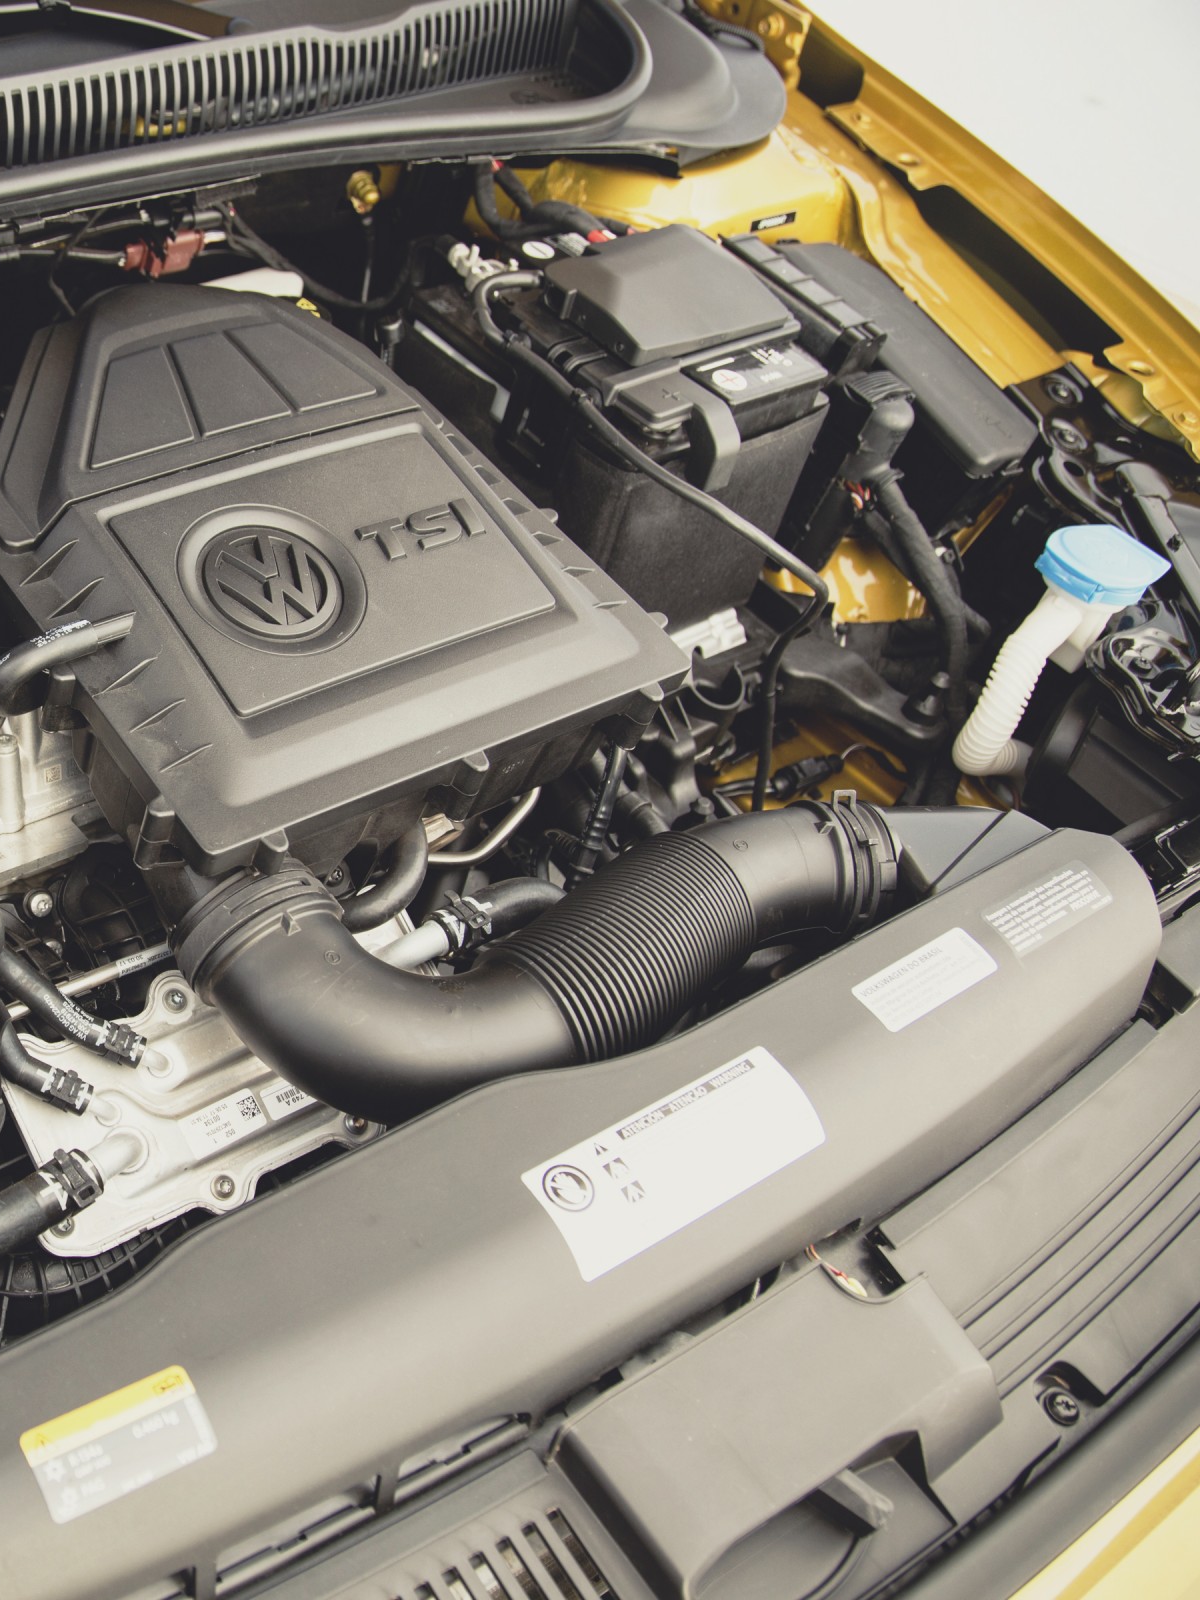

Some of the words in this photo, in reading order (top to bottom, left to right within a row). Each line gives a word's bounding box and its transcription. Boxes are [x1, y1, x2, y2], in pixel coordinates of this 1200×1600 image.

[355, 498, 486, 562] TSI
[860, 965, 908, 997] VOLKSWAGEN
[907, 959, 919, 969] DO
[918, 945, 942, 962] BRASIL
[708, 1060, 751, 1090] WARNING
